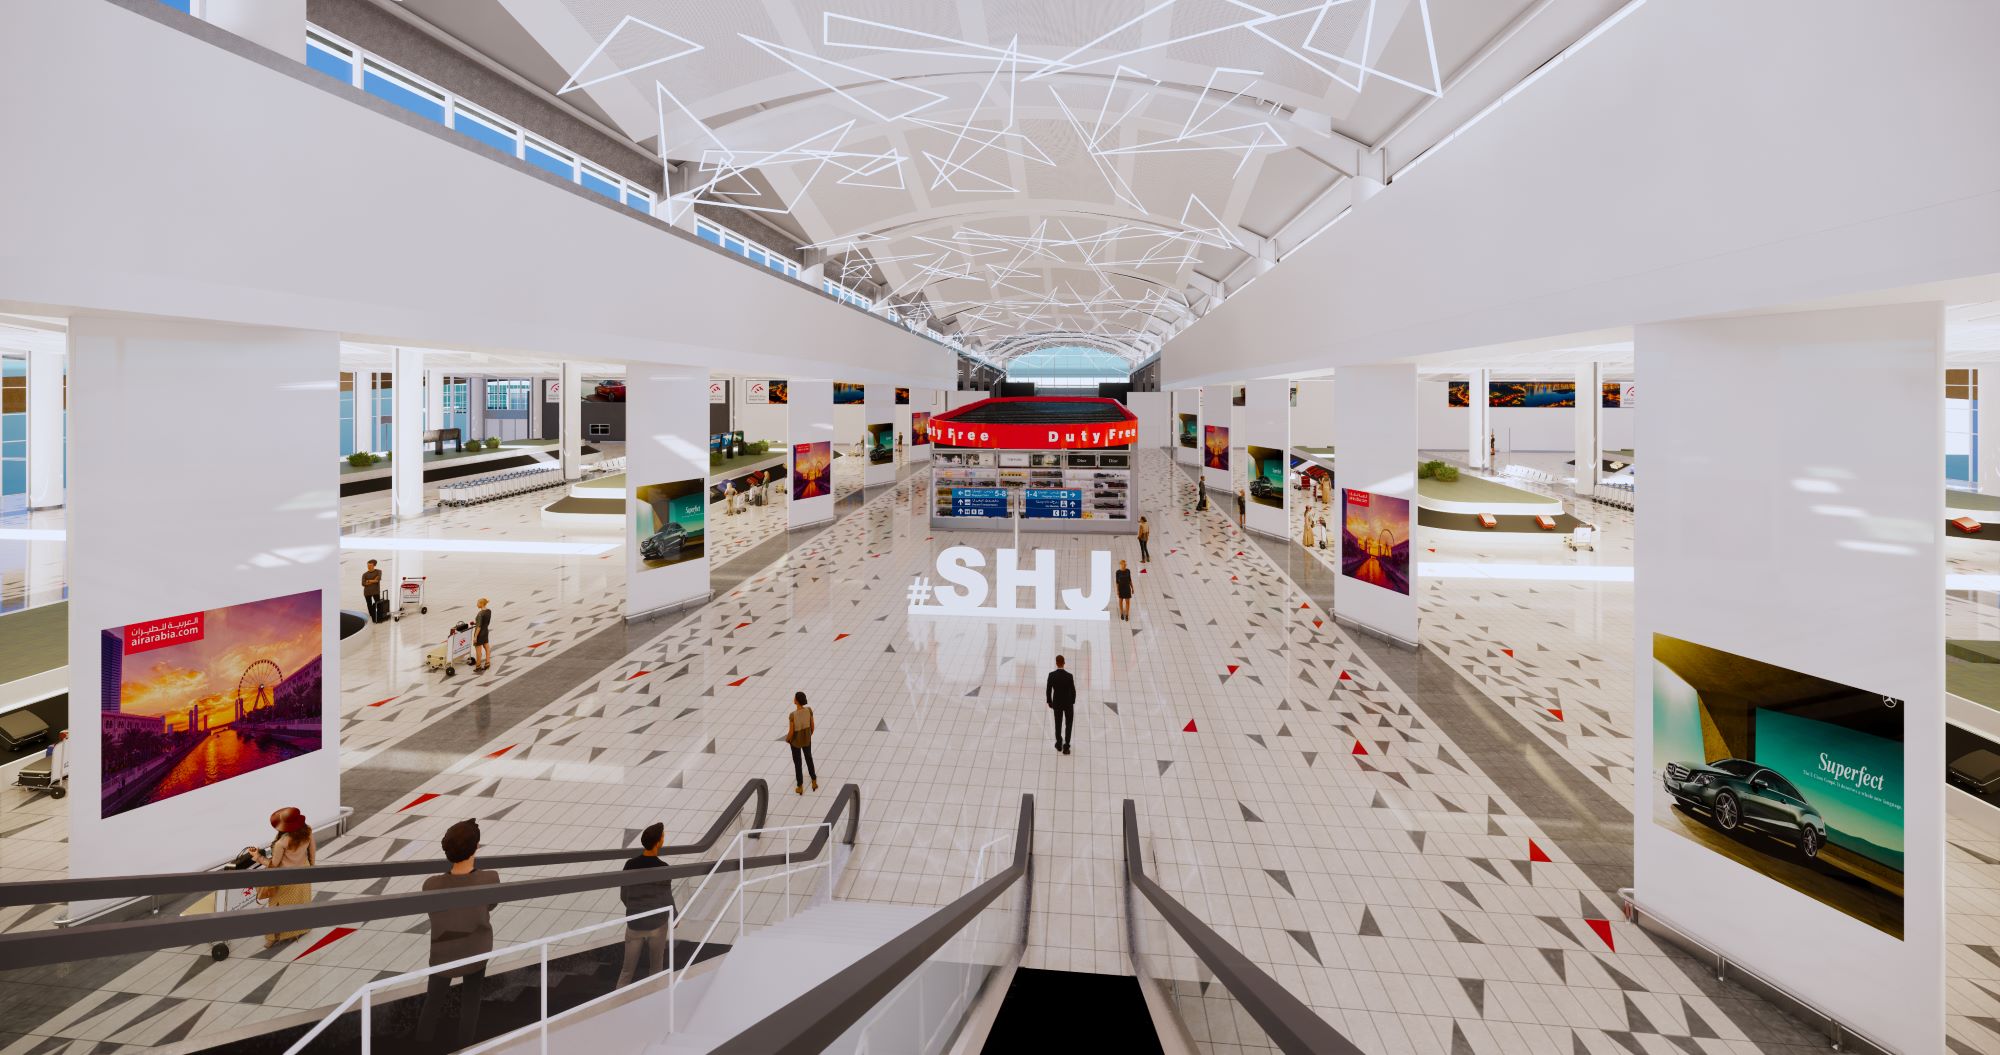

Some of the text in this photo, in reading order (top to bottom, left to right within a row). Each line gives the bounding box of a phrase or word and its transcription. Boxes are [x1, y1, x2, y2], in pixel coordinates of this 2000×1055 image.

[947, 427, 989, 441] Free
[1048, 428, 1136, 444] Duty Free
[1026, 490, 1038, 498] 1-4
[906, 546, 1112, 610] #SHJ
[131, 627, 199, 647] airarabia.com
[1818, 752, 1884, 791] Superfect
